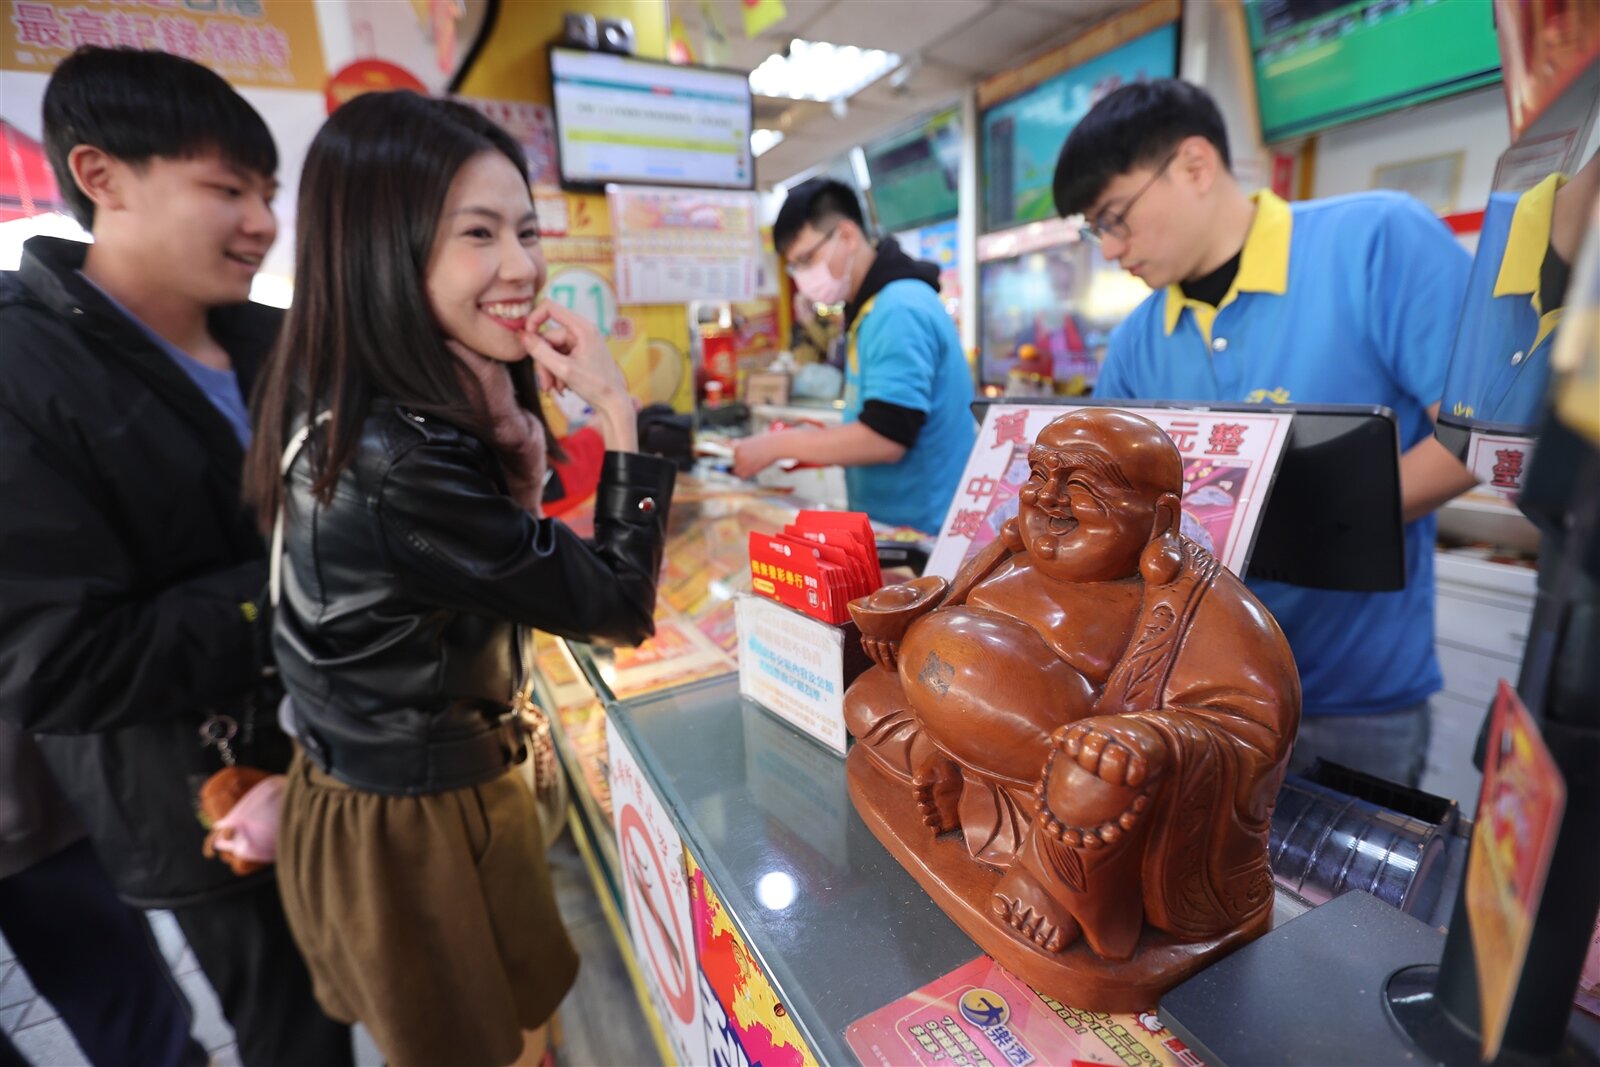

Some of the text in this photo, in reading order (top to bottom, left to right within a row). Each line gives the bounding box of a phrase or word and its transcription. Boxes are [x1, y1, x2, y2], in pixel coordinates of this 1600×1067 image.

[991, 409, 1029, 449] 賀
[1166, 421, 1249, 455] 元整
[948, 474, 997, 540] 中獎
[960, 993, 1033, 1066] 大樂透
